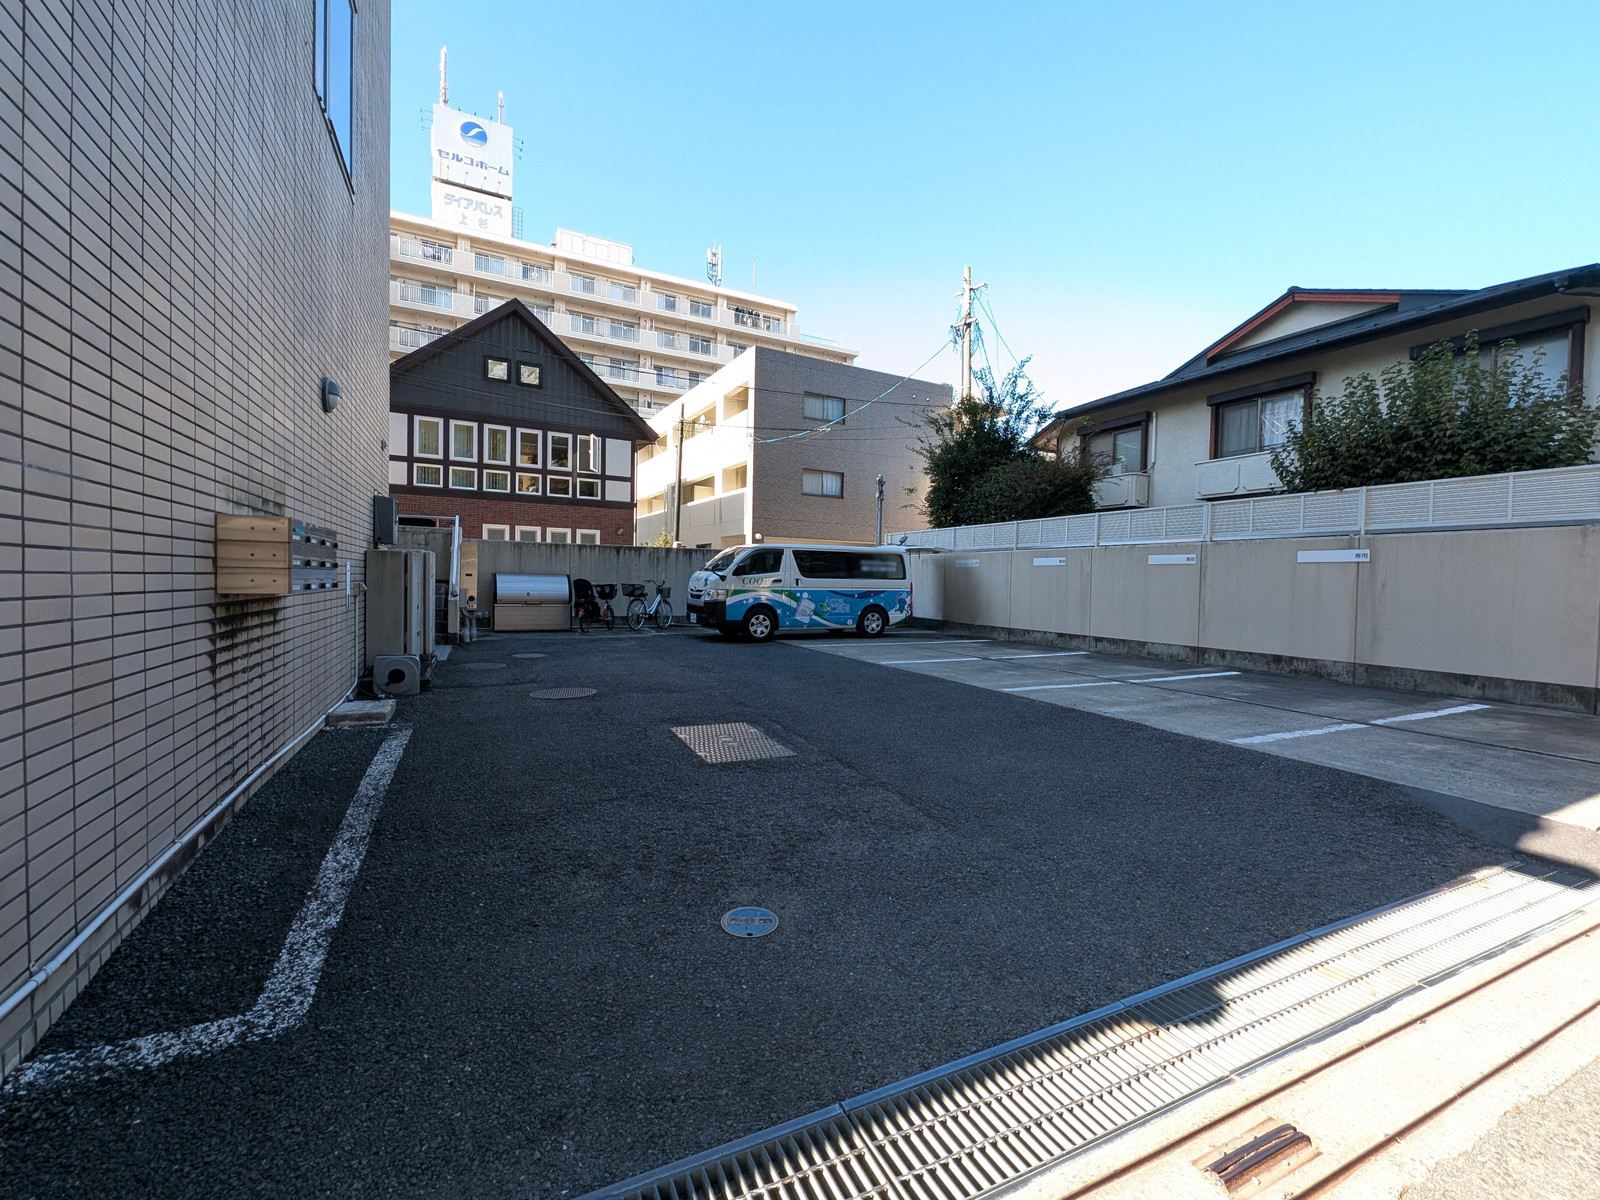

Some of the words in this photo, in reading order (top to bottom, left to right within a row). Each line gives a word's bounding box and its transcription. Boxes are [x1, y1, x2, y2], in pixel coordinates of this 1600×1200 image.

[437, 148, 510, 176] セルコホーム
